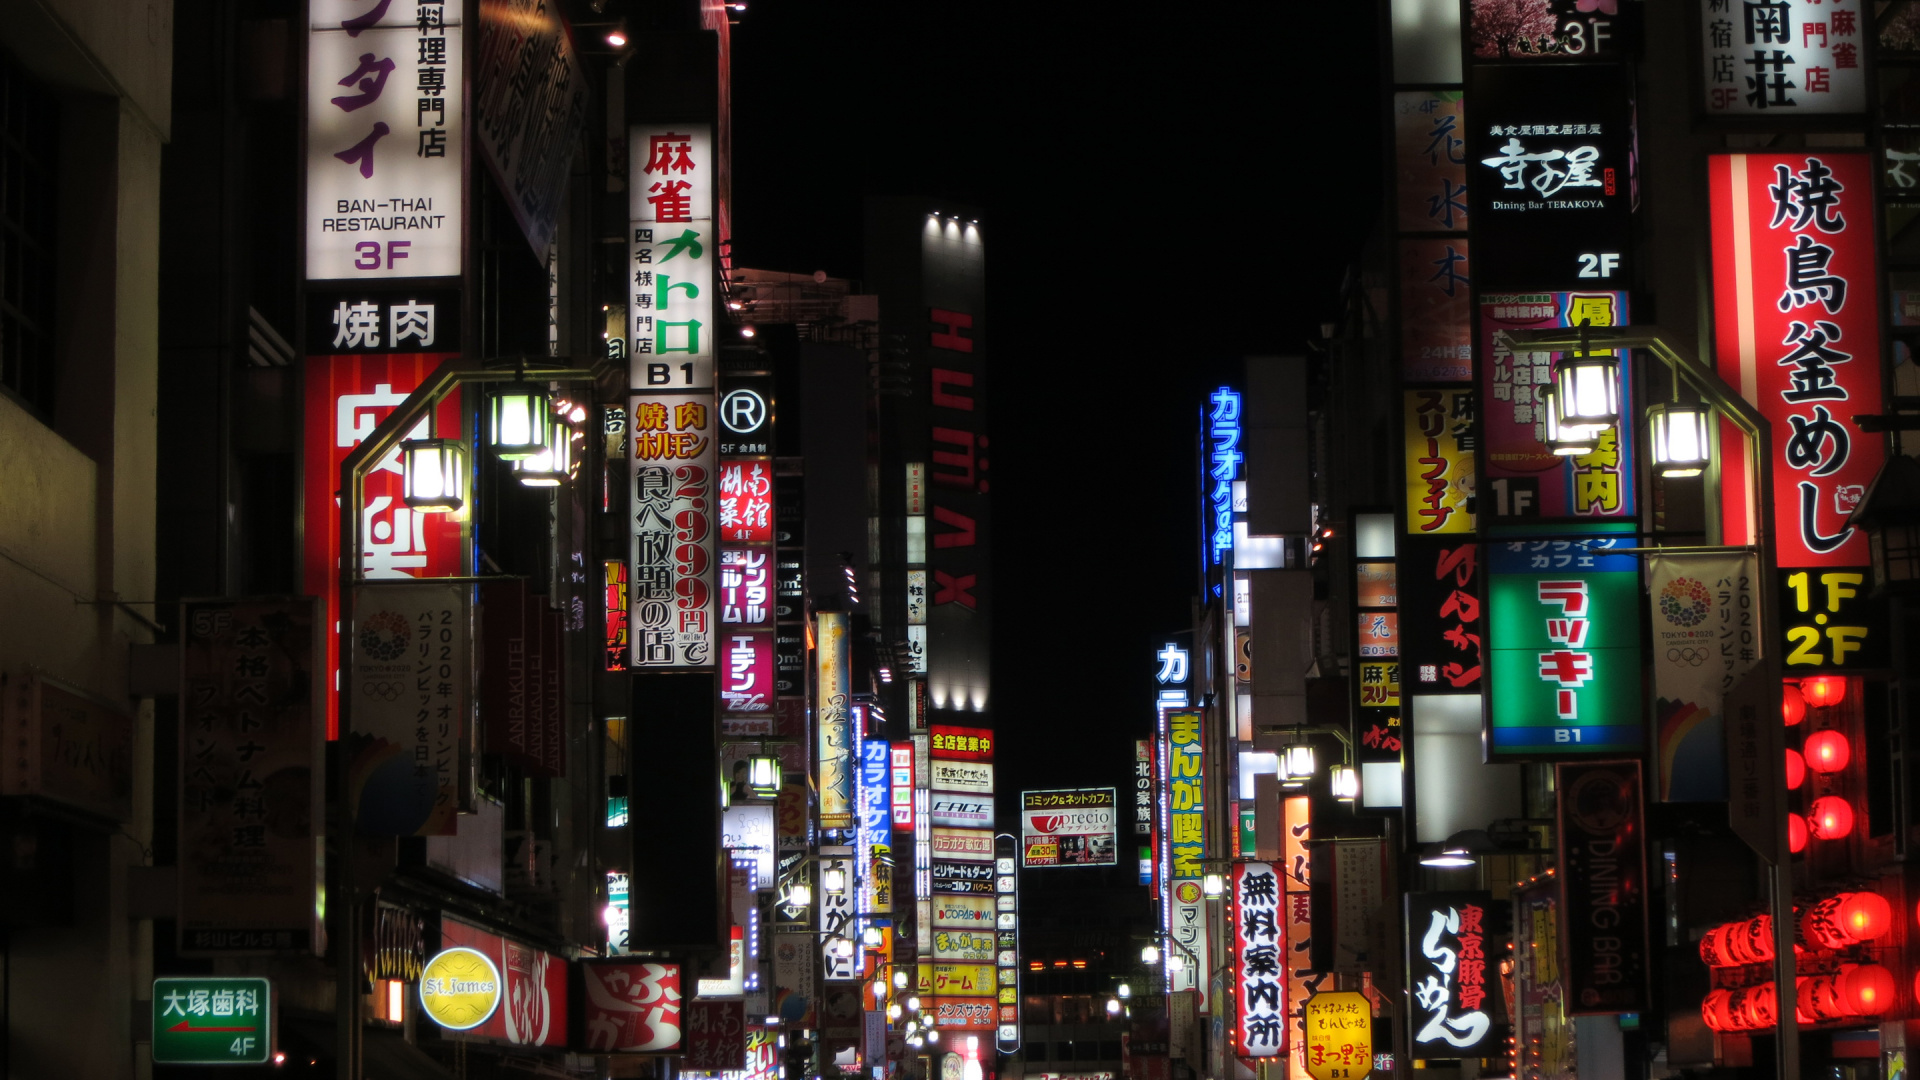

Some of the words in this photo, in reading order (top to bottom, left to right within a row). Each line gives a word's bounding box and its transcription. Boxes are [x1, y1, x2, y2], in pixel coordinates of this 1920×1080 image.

[1564, 21, 1611, 54] 3F
[1802, 0, 1830, 93] 門店
[416, 0, 447, 158] 料理専門店
[643, 132, 696, 223] 麻雀
[1480, 137, 1603, 198] 寺子屋
[336, 198, 432, 213] BAN-THAI
[1493, 201, 1526, 211] Dining
[1528, 201, 1544, 209] Bar
[1547, 200, 1604, 209] TERAKOYA
[322, 215, 445, 232] RESTAURANT
[354, 241, 411, 270] 3F
[1577, 253, 1619, 278] 2F
[634, 229, 653, 354] 四名様専門店
[655, 229, 703, 355] メトロ
[333, 299, 435, 348] 焼肉
[1768, 157, 1854, 555] 焼鳥釜めし
[647, 363, 693, 385] B1
[635, 402, 707, 432] 焼肉
[635, 433, 709, 460] ホルモン
[721, 444, 735, 453] 5F
[739, 443, 767, 453] 会員制
[1415, 390, 1454, 532] スリーファイブ
[1492, 479, 1533, 516] 1F
[733, 530, 752, 540] 4F
[635, 465, 675, 664] 食べ放題の店
[1531, 554, 1595, 568] カフェ
[722, 569, 743, 624] ルーム
[745, 550, 767, 623] レンタル
[1661, 631, 1687, 639] TOKYO
[1695, 630, 1714, 639] 2020
[1786, 626, 1868, 666] 2F
[731, 636, 756, 692] エデン
[1537, 579, 1594, 720] ラッキー
[508, 637, 523, 748] ANRAKUTEI
[727, 693, 769, 712] Eden
[233, 625, 270, 849] 本格ベトナム料理
[932, 733, 991, 753] 全店営業中
[1554, 728, 1581, 743] B1
[1026, 793, 1112, 806] コミック&ネットカフェ
[1135, 762, 1151, 822] 北の家族
[1170, 713, 1203, 877] まんが喫茶
[934, 801, 992, 814] FACE
[1046, 809, 1109, 831] aprecio
[1066, 824, 1108, 832] アプレシオ
[935, 836, 991, 851] カラオケ歌広場
[876, 864, 890, 905] 麻雀
[933, 864, 993, 880] ビリヤード&ダーツ
[952, 880, 972, 892] ゴルフ
[1587, 840, 1620, 929] DINING
[935, 931, 993, 953] まんが喫茶
[1457, 903, 1487, 1010] 東京豚骨
[1240, 871, 1281, 1048] 無料案内所
[1592, 936, 1623, 986] BAR
[936, 974, 973, 990] ゲーム
[162, 988, 259, 1017] 大塚歯科
[938, 1002, 992, 1017] メンズサウナ
[1310, 1003, 1359, 1015] お好み焼
[1319, 1017, 1367, 1030] もんじゃ焼
[229, 1037, 256, 1056] 4F
[1310, 1043, 1369, 1066] まつ里亭
[1331, 1069, 1349, 1079] B1
